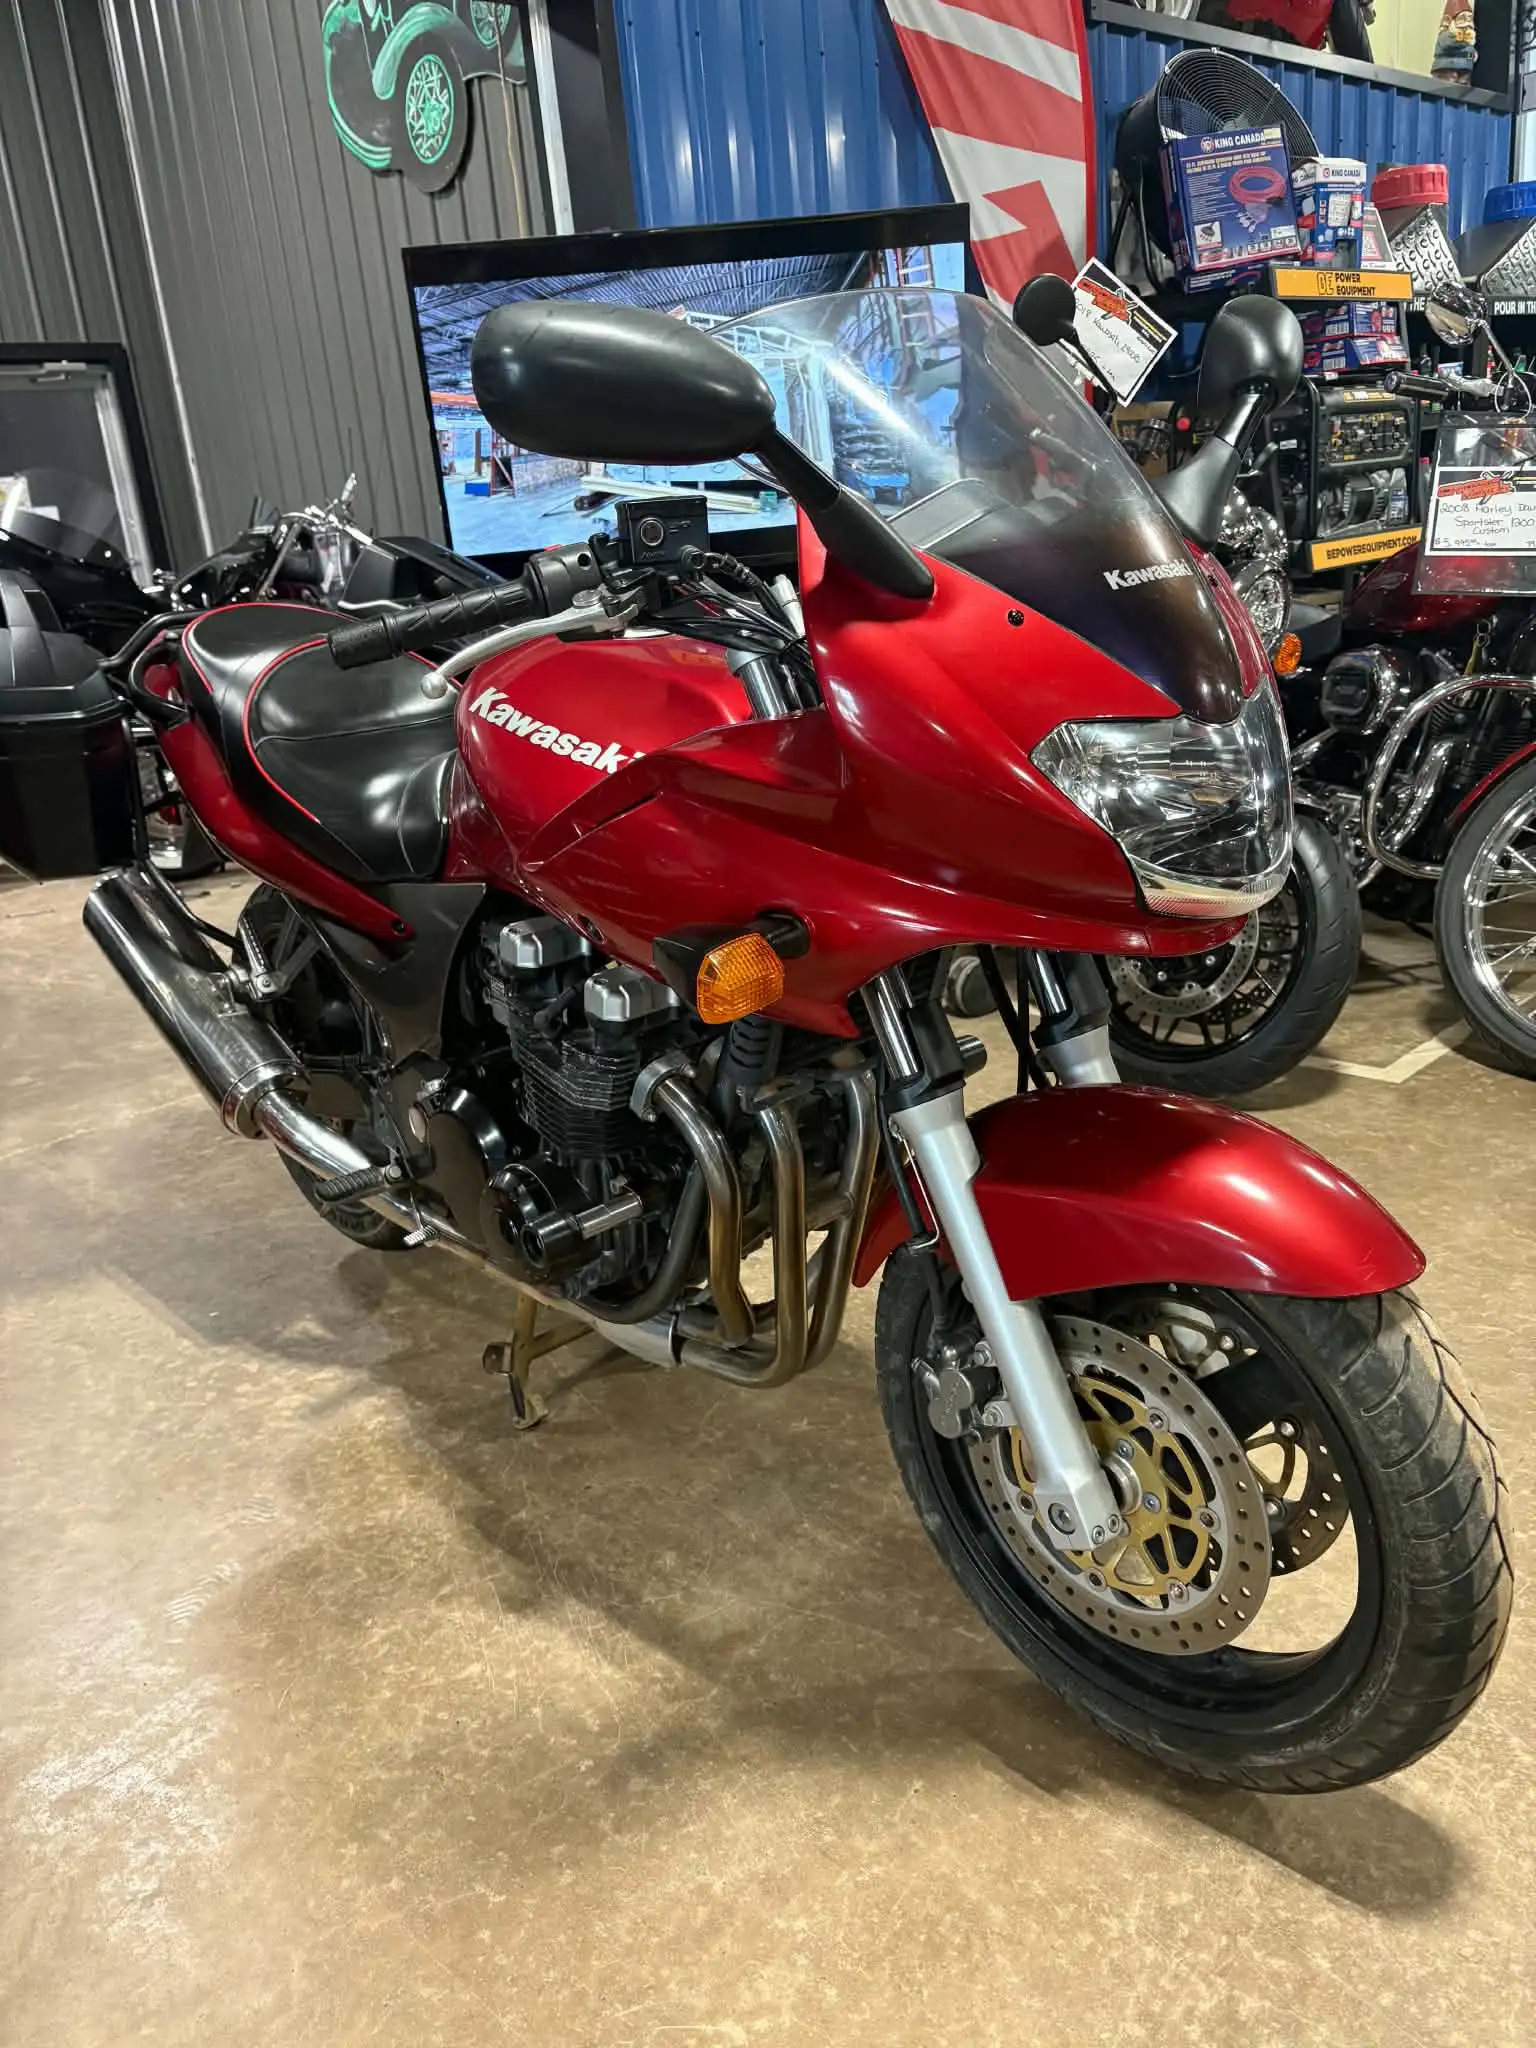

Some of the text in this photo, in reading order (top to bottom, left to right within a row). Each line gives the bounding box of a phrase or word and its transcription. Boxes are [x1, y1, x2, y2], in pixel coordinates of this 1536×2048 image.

[1214, 132, 1266, 149] KING CANADA
[1335, 272, 1361, 283] POWER
[1336, 286, 1377, 297] EQUIPMENT
[1494, 301, 1516, 315] POUR
[1440, 502, 1470, 513] 2008
[1475, 504, 1513, 516] Harley
[1454, 516, 1535, 528] Sportster 1200
[1471, 526, 1510, 536] Custom
[1326, 535, 1418, 560] BEPOWEREQUIPMENT.COM
[1103, 558, 1194, 590] Kawasaki
